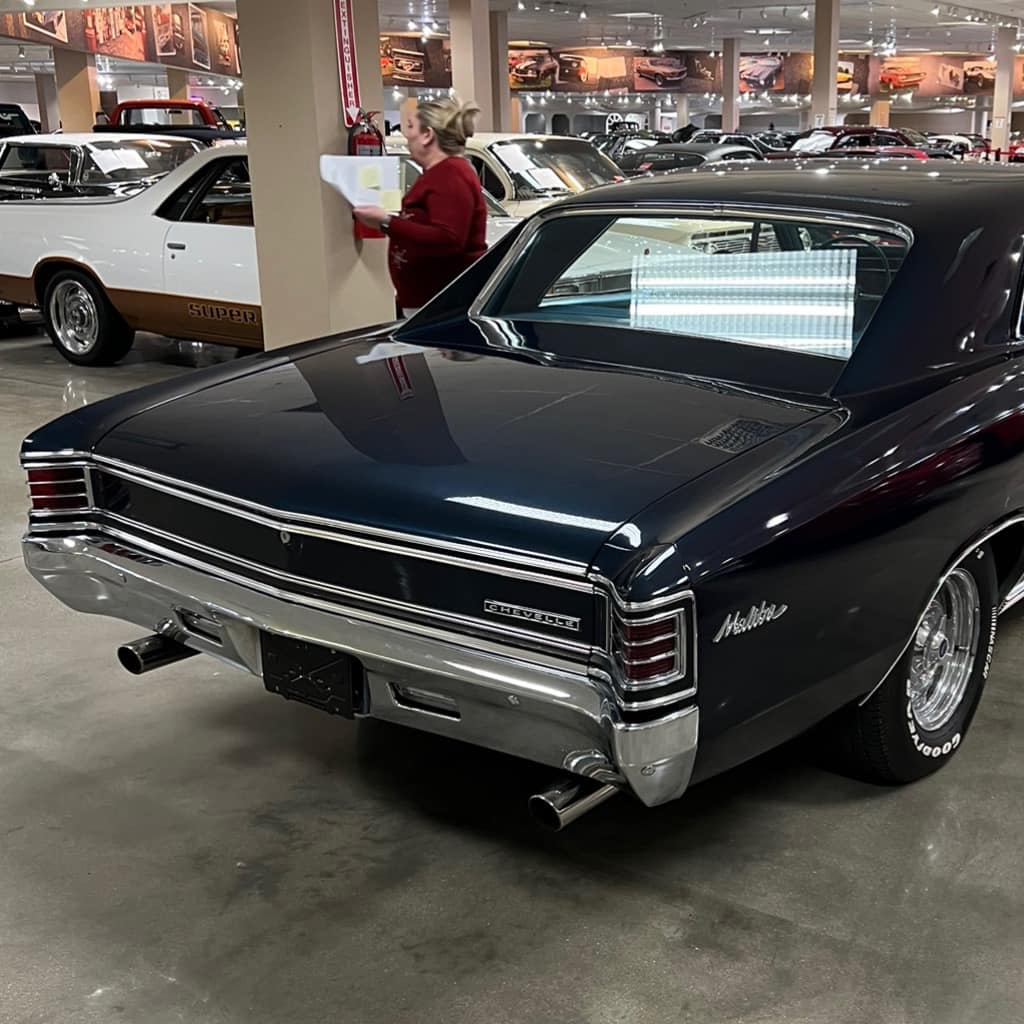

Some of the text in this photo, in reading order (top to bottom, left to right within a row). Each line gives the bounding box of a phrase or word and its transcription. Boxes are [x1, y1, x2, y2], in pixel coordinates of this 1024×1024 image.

[187, 302, 257, 324] SUPER
[488, 604, 575, 627] CHEVELLE
[712, 600, 789, 643] Malibu
